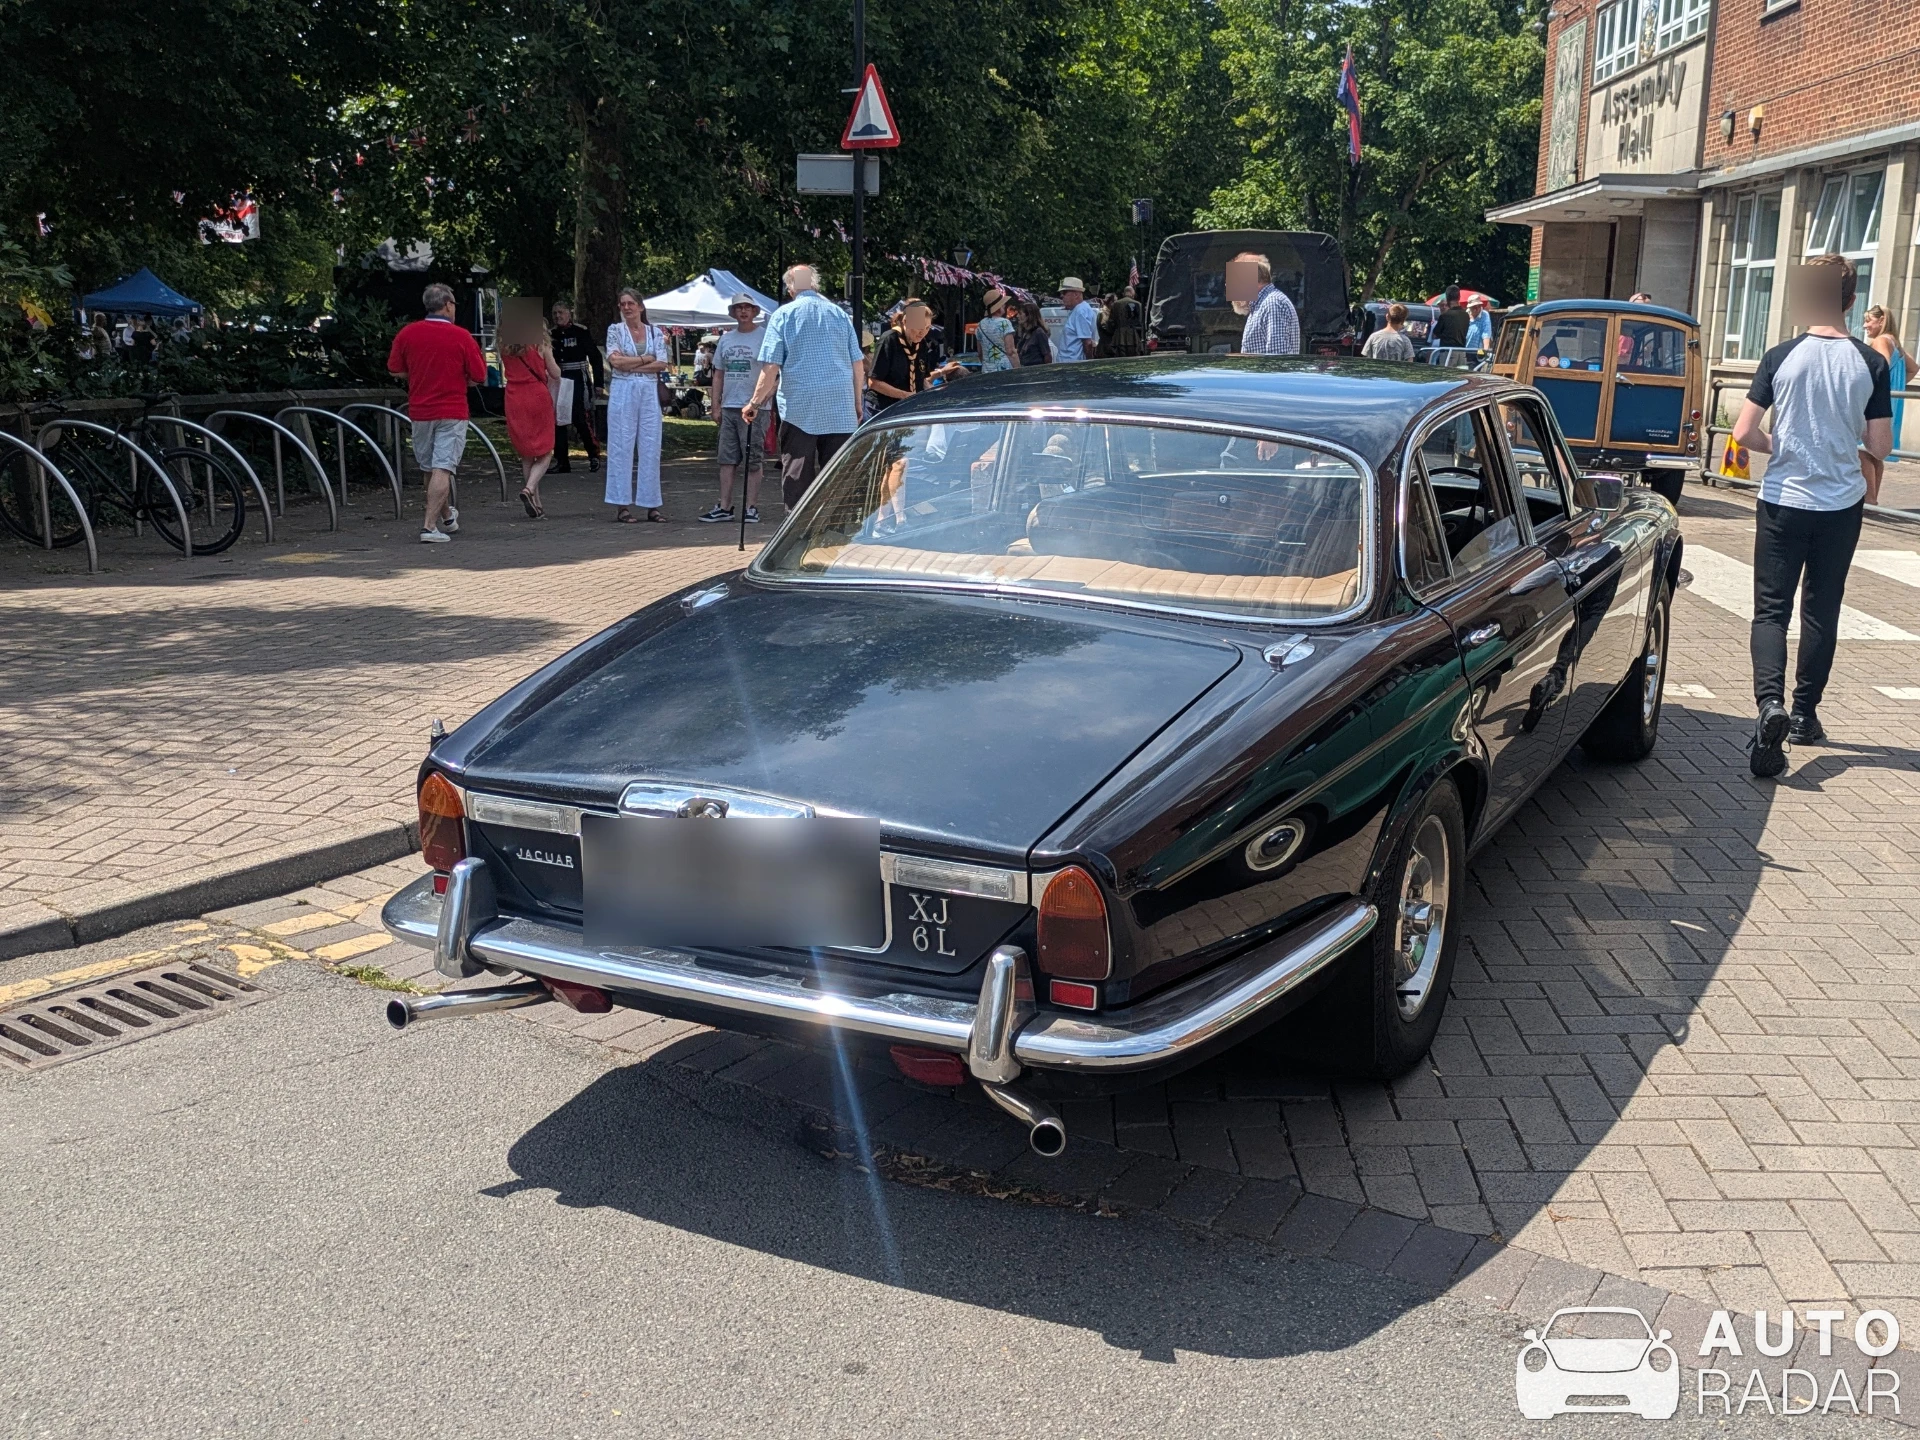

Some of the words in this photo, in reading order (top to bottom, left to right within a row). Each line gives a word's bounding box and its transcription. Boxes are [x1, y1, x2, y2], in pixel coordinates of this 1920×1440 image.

[1601, 52, 1686, 125] Assembly
[1617, 113, 1654, 163] Hall
[516, 848, 574, 868] JAGUAR
[908, 892, 950, 924] XJ
